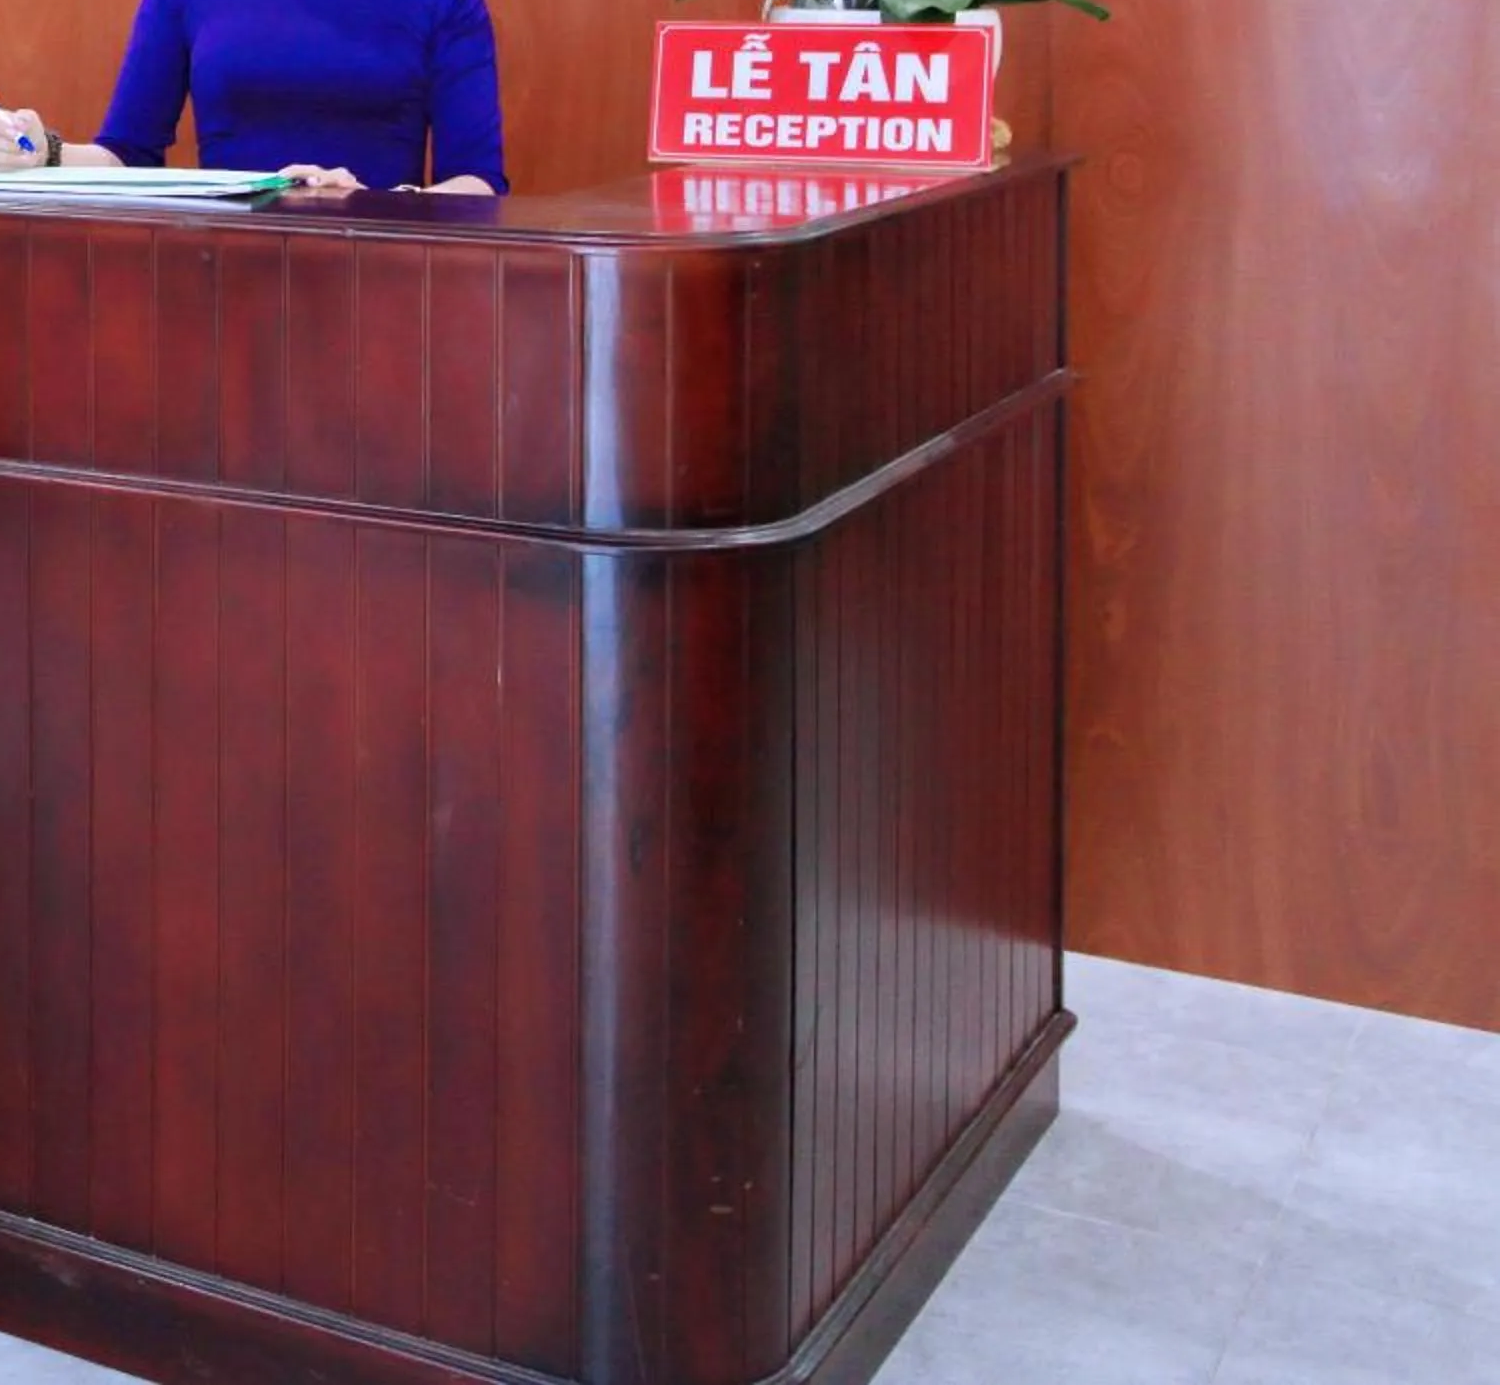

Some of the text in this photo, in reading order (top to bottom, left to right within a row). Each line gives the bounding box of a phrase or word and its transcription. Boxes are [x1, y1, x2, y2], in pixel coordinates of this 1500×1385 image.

[691, 33, 949, 103] LỄ TÂN
[683, 112, 953, 152] RECEPTION
